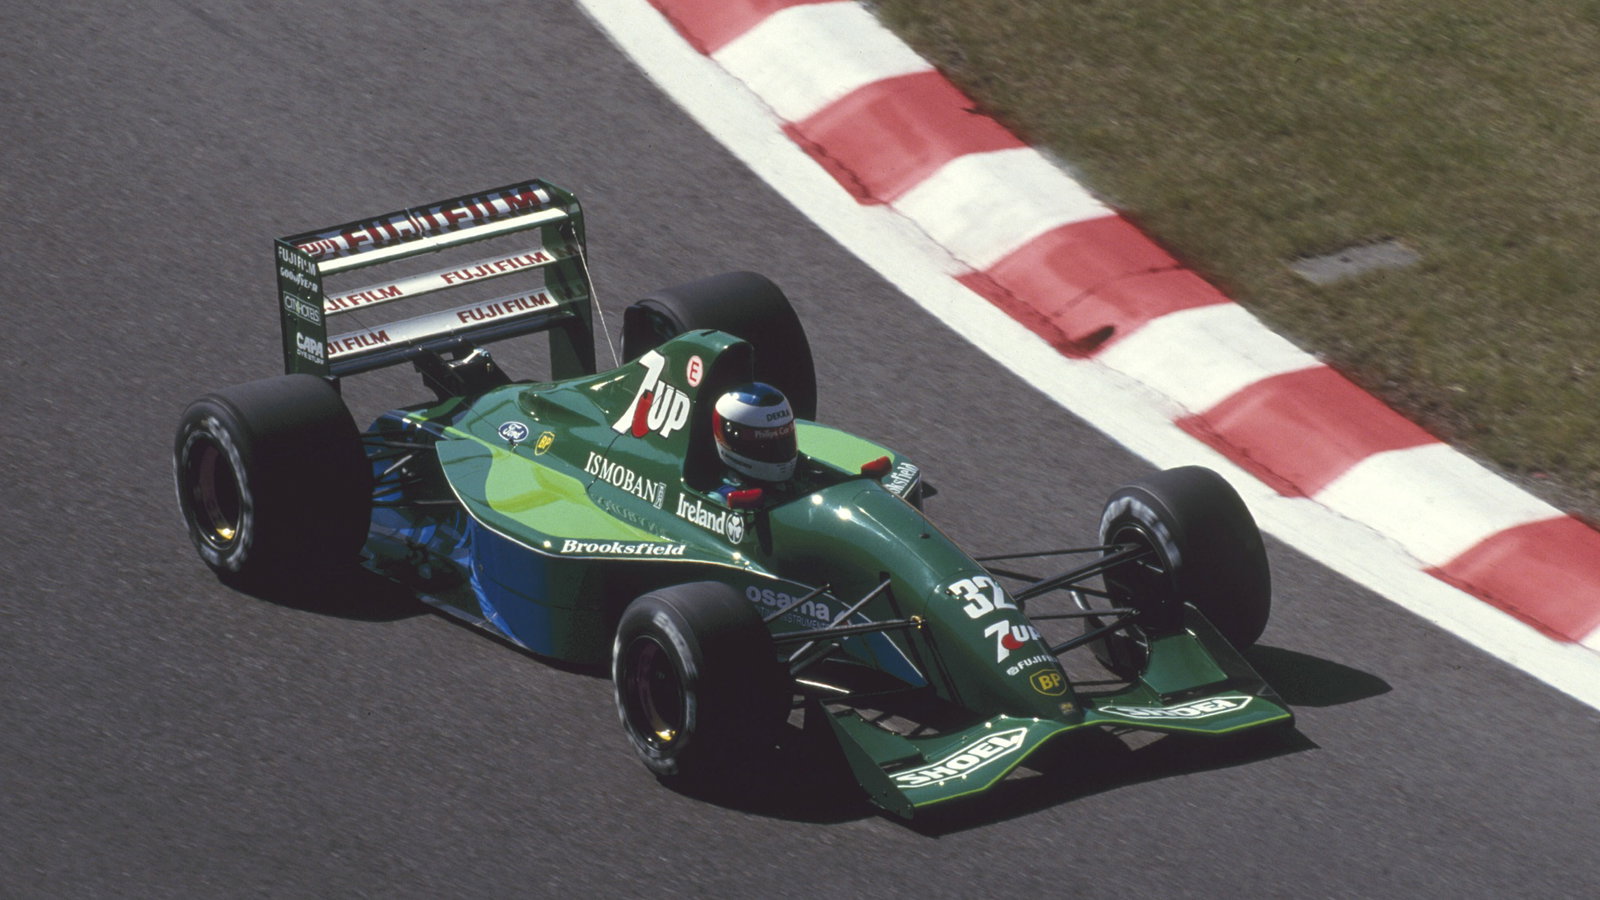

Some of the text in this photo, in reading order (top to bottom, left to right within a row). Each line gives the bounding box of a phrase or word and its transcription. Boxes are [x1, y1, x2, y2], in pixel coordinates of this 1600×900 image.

[324, 284, 403, 312] JIFILM
[327, 329, 391, 355] JIFILM
[689, 361, 700, 382] E
[502, 423, 525, 440] Ford
[537, 435, 554, 450] BP
[584, 451, 658, 502] ISMOBAN
[884, 462, 919, 494] oksfield
[676, 493, 726, 534] Ireland
[560, 539, 686, 555] Brooksfield
[745, 585, 830, 621] osama
[947, 575, 1018, 619] 32
[1038, 673, 1060, 690] BP
